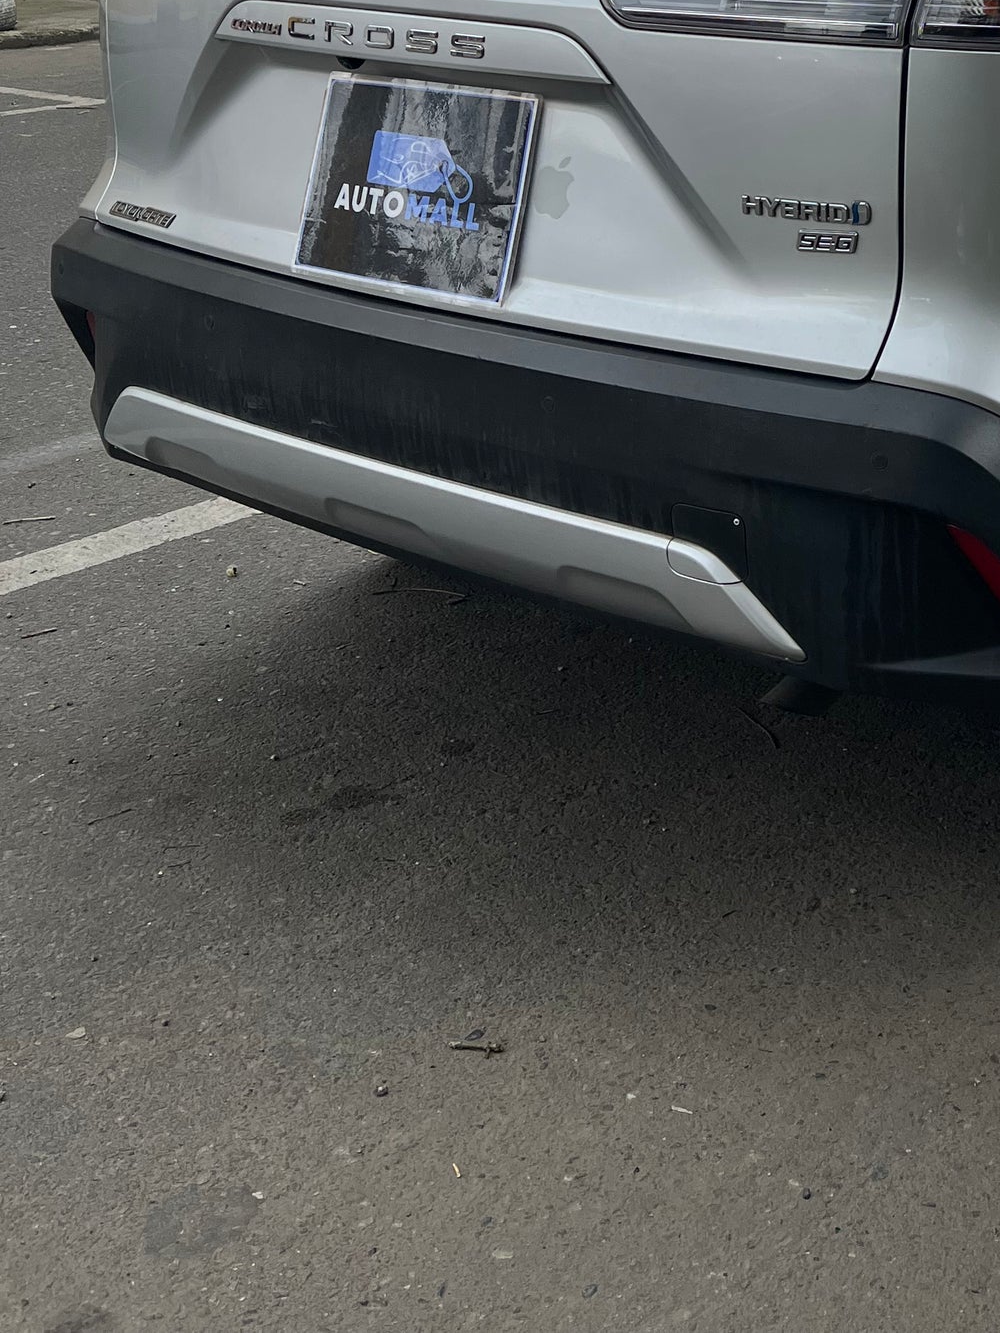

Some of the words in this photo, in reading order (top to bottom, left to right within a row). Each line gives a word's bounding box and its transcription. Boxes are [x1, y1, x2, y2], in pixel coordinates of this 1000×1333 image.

[231, 18, 282, 36] COROLLA
[288, 16, 486, 59] CROSS
[333, 183, 480, 231] AUTOMALL
[741, 194, 850, 224] HYBRID
